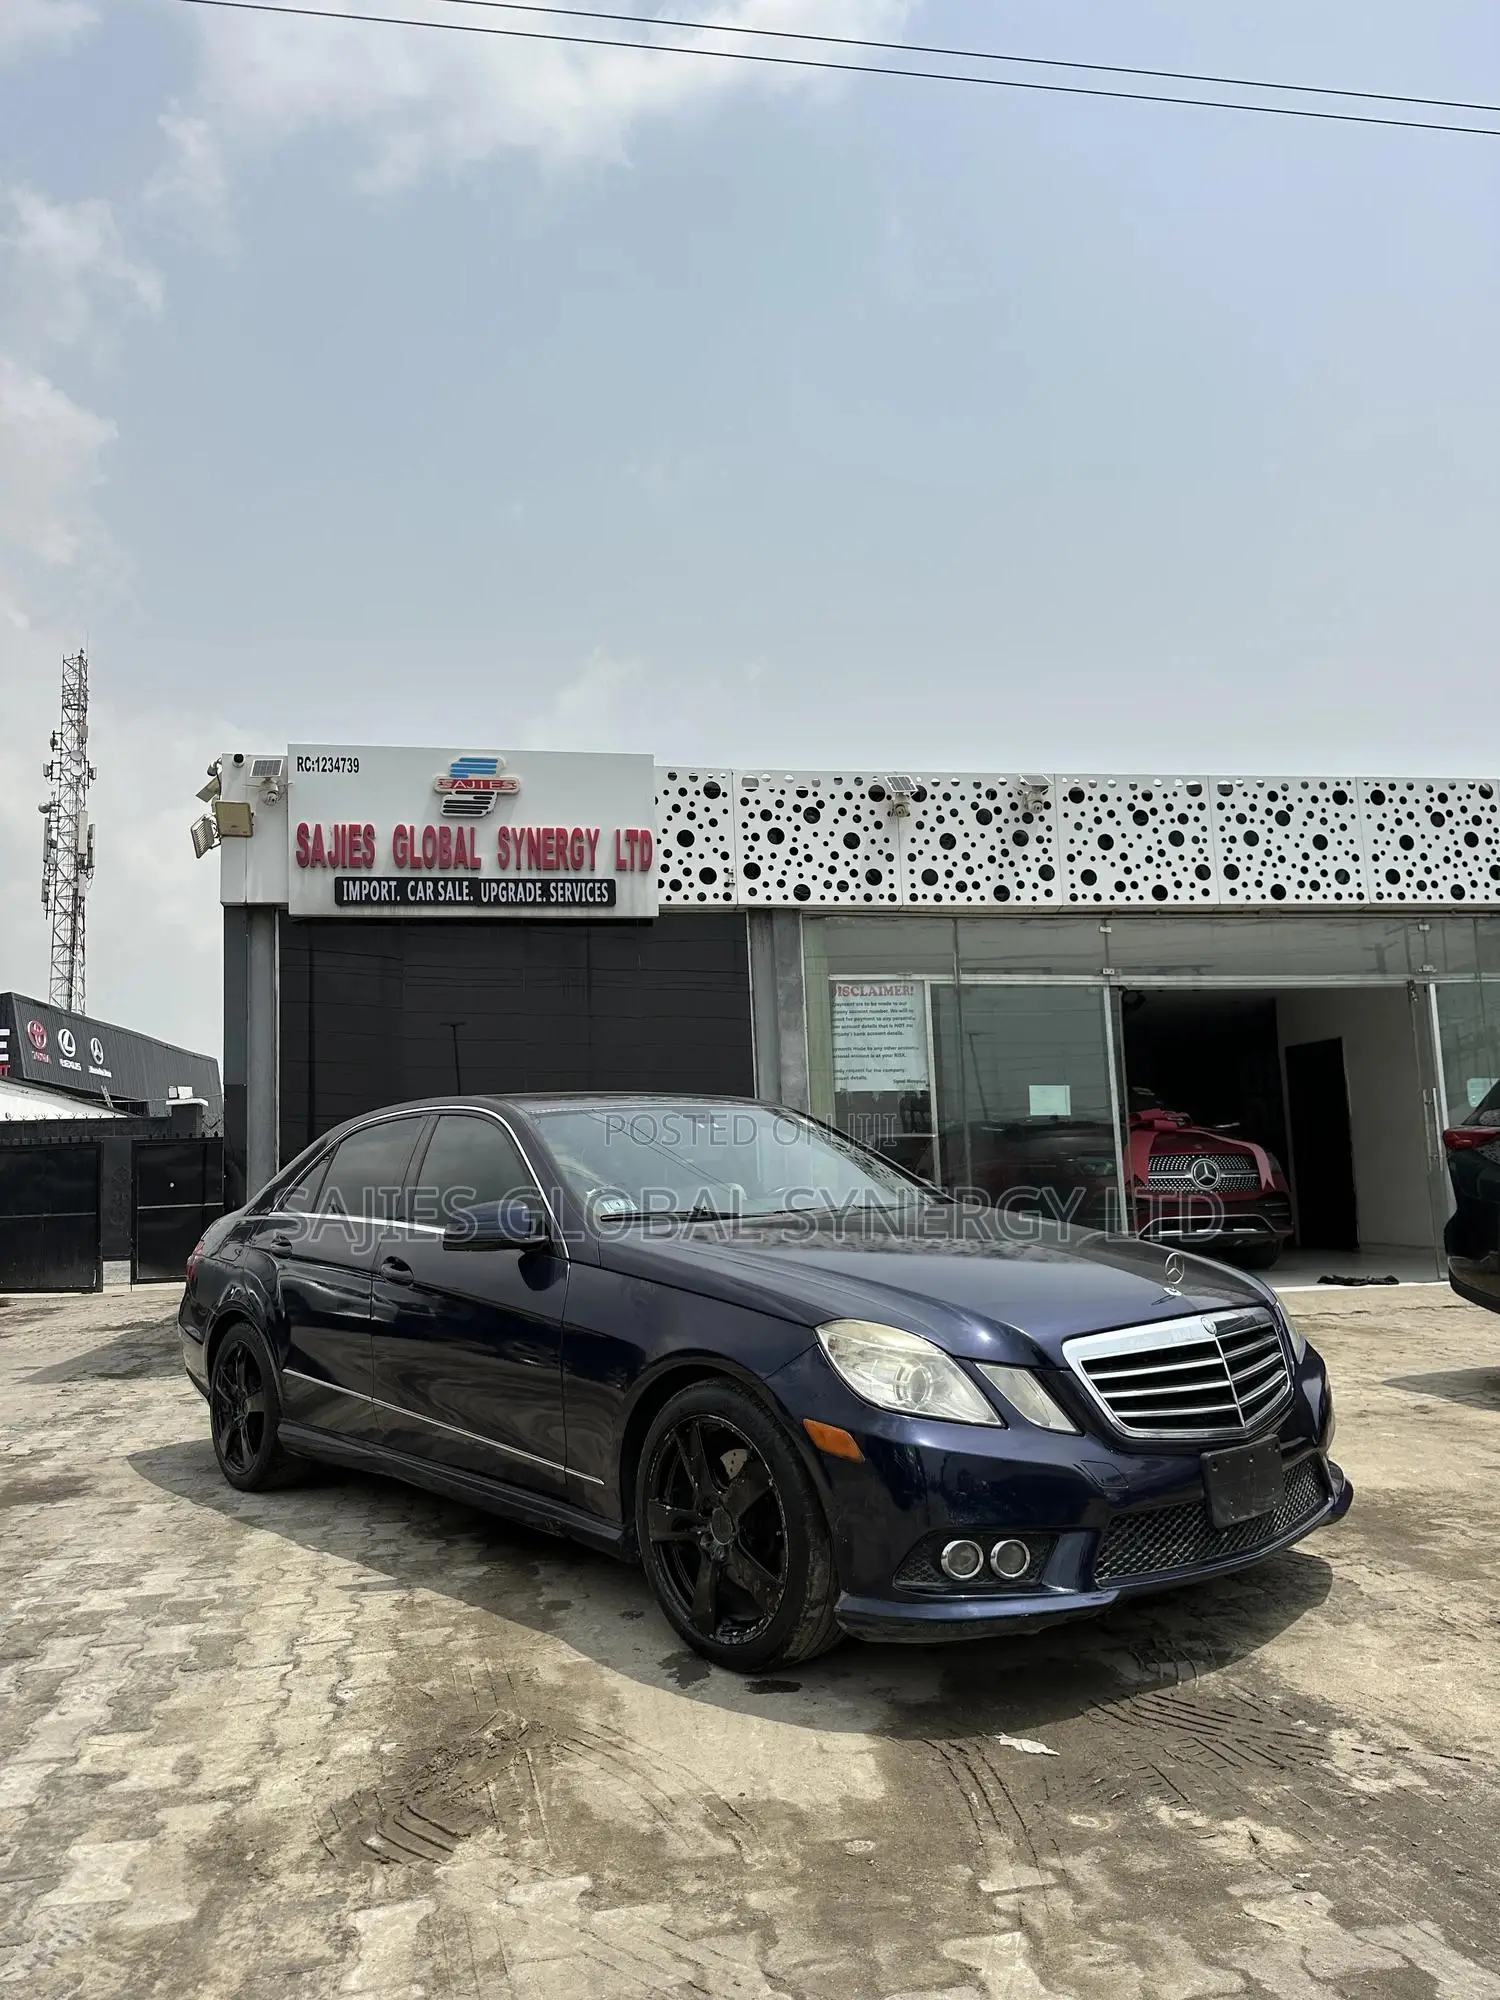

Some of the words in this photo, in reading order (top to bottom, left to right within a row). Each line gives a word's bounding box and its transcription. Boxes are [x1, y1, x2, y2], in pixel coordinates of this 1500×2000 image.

[296, 756, 360, 774] RC:1234739
[438, 778, 518, 791] SAJIES
[295, 822, 376, 869] SAJIES
[392, 824, 482, 870] GLOBAL
[497, 825, 600, 871] SYNERGY
[614, 828, 654, 872] LTD
[342, 880, 400, 902] IMPORT.
[407, 881, 434, 902] CAR
[437, 881, 474, 902] SALE.
[480, 881, 547, 903] UPGRADE.
[549, 882, 609, 903] SERVICES
[834, 984, 914, 997] ISCLAIMER!
